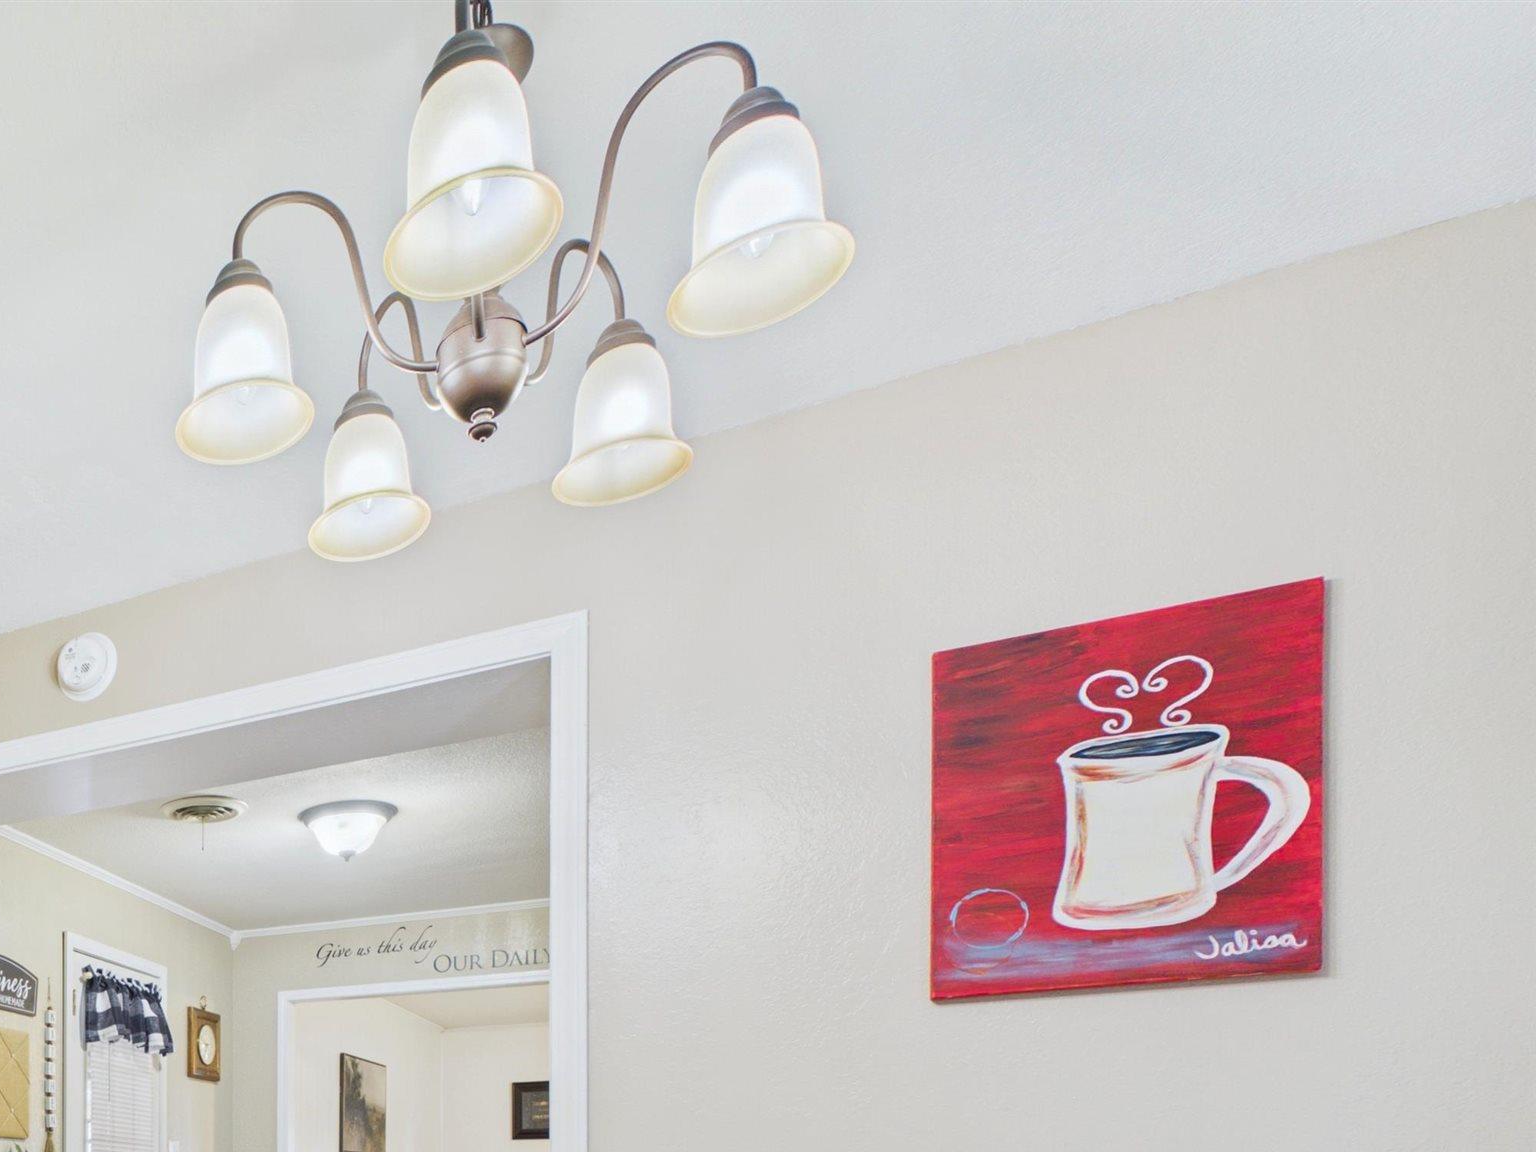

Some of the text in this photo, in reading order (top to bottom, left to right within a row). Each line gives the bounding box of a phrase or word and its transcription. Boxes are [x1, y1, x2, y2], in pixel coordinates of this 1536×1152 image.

[316, 925, 438, 968] Give us this day
[1193, 929, 1308, 960] Jalisa
[433, 954, 483, 973] OUR
